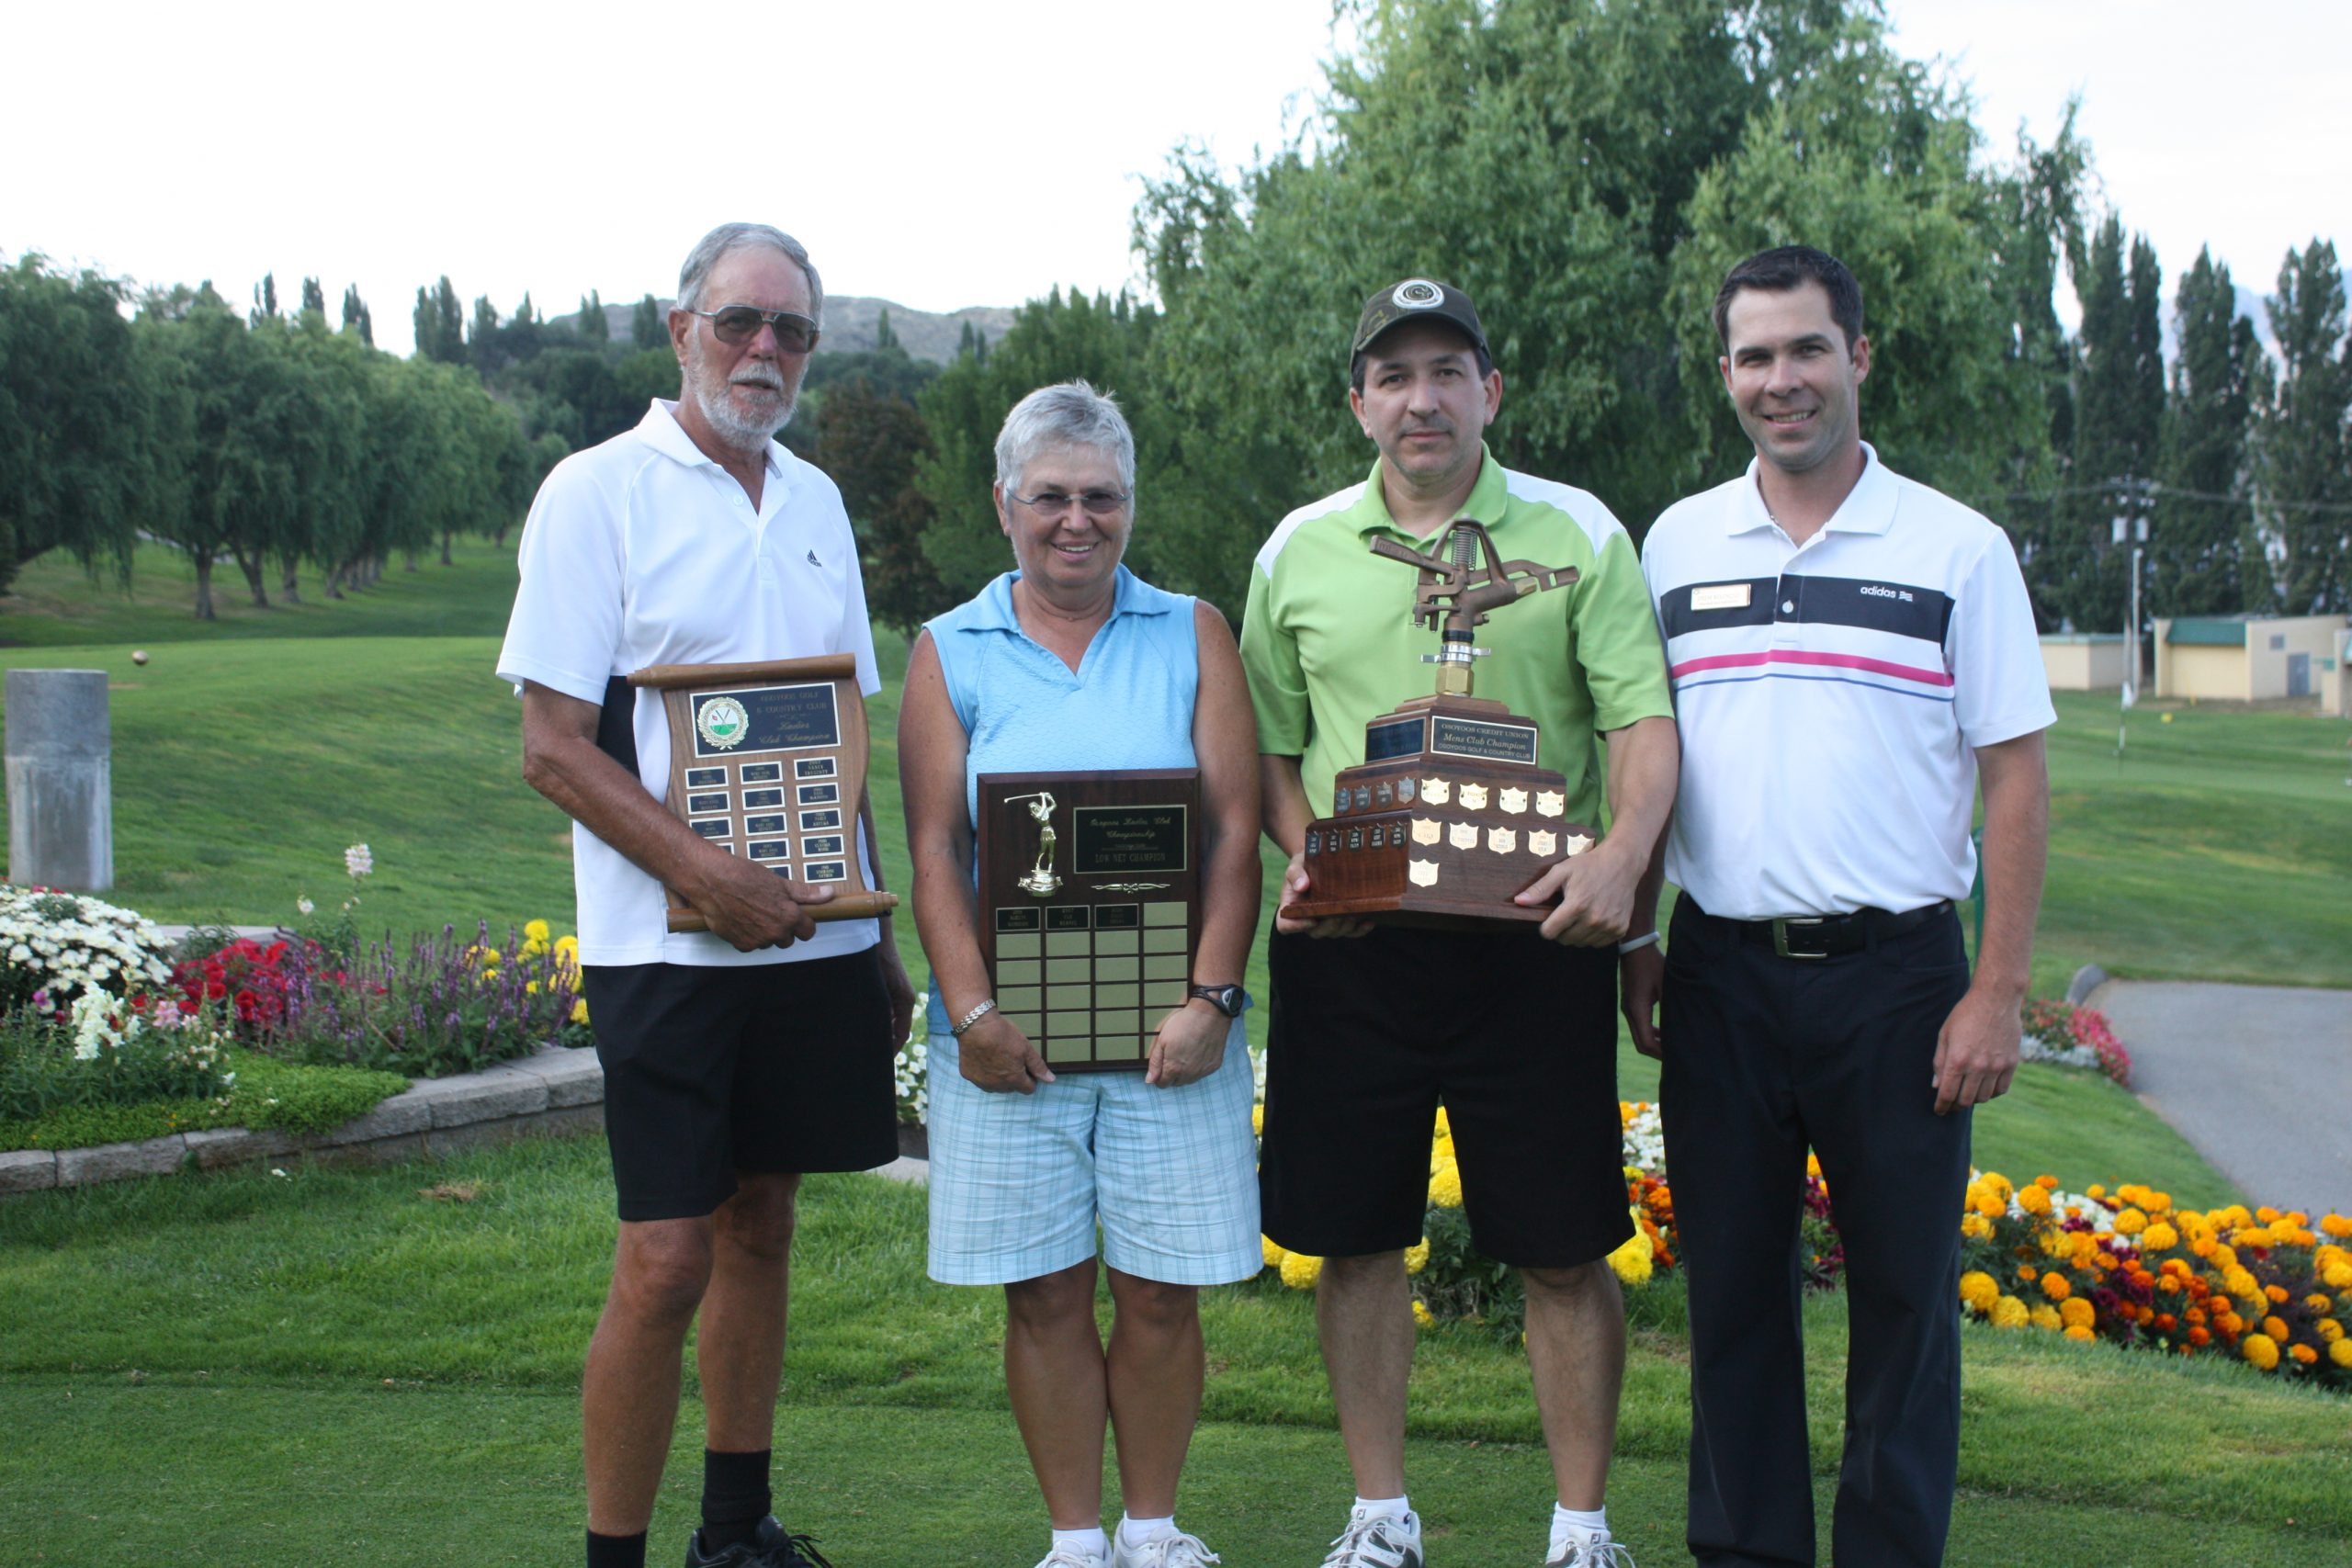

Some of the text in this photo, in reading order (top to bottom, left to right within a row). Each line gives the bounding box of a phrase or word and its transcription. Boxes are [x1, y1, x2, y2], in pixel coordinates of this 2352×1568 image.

[1860, 585, 1896, 599] adidas
[765, 705, 802, 713] COUNTRY
[806, 702, 827, 710] CLUB
[1441, 723, 1530, 739] OSOYOOS CREDIT UNION
[1443, 733, 1526, 750] Mens Club Champion
[1438, 742, 1467, 751] OSOYOOS
[1488, 749, 1515, 757] COUNTRY
[1589, 1532, 1601, 1545] FJ
